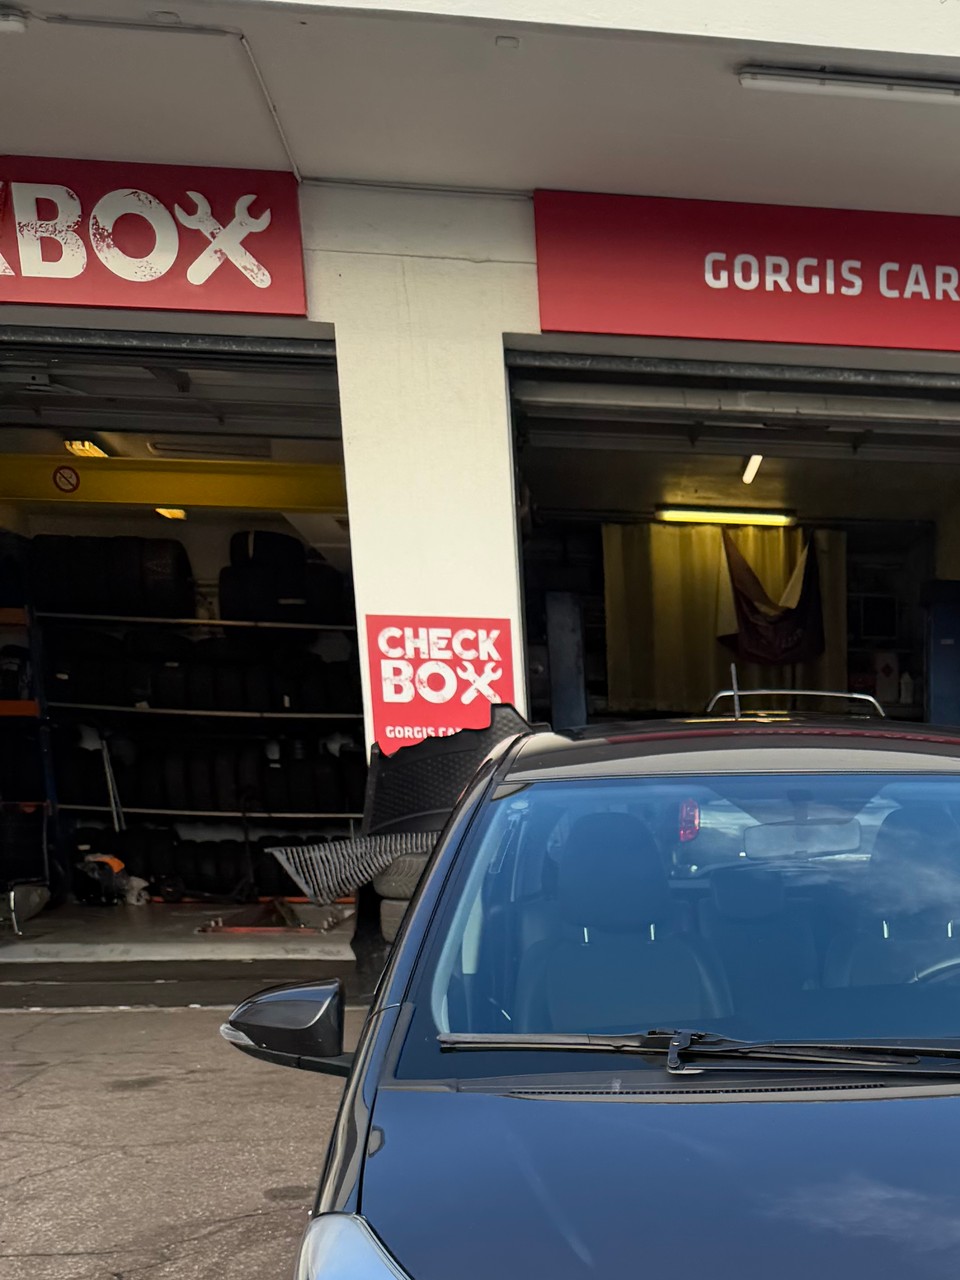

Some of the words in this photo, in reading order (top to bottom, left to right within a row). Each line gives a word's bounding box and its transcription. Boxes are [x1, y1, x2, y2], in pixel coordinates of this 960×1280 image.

[0, 181, 272, 288] BOX
[704, 252, 863, 296] GORGIS
[377, 626, 502, 661] CHECK
[380, 659, 503, 705] BOX
[385, 725, 435, 739] GORGIS
